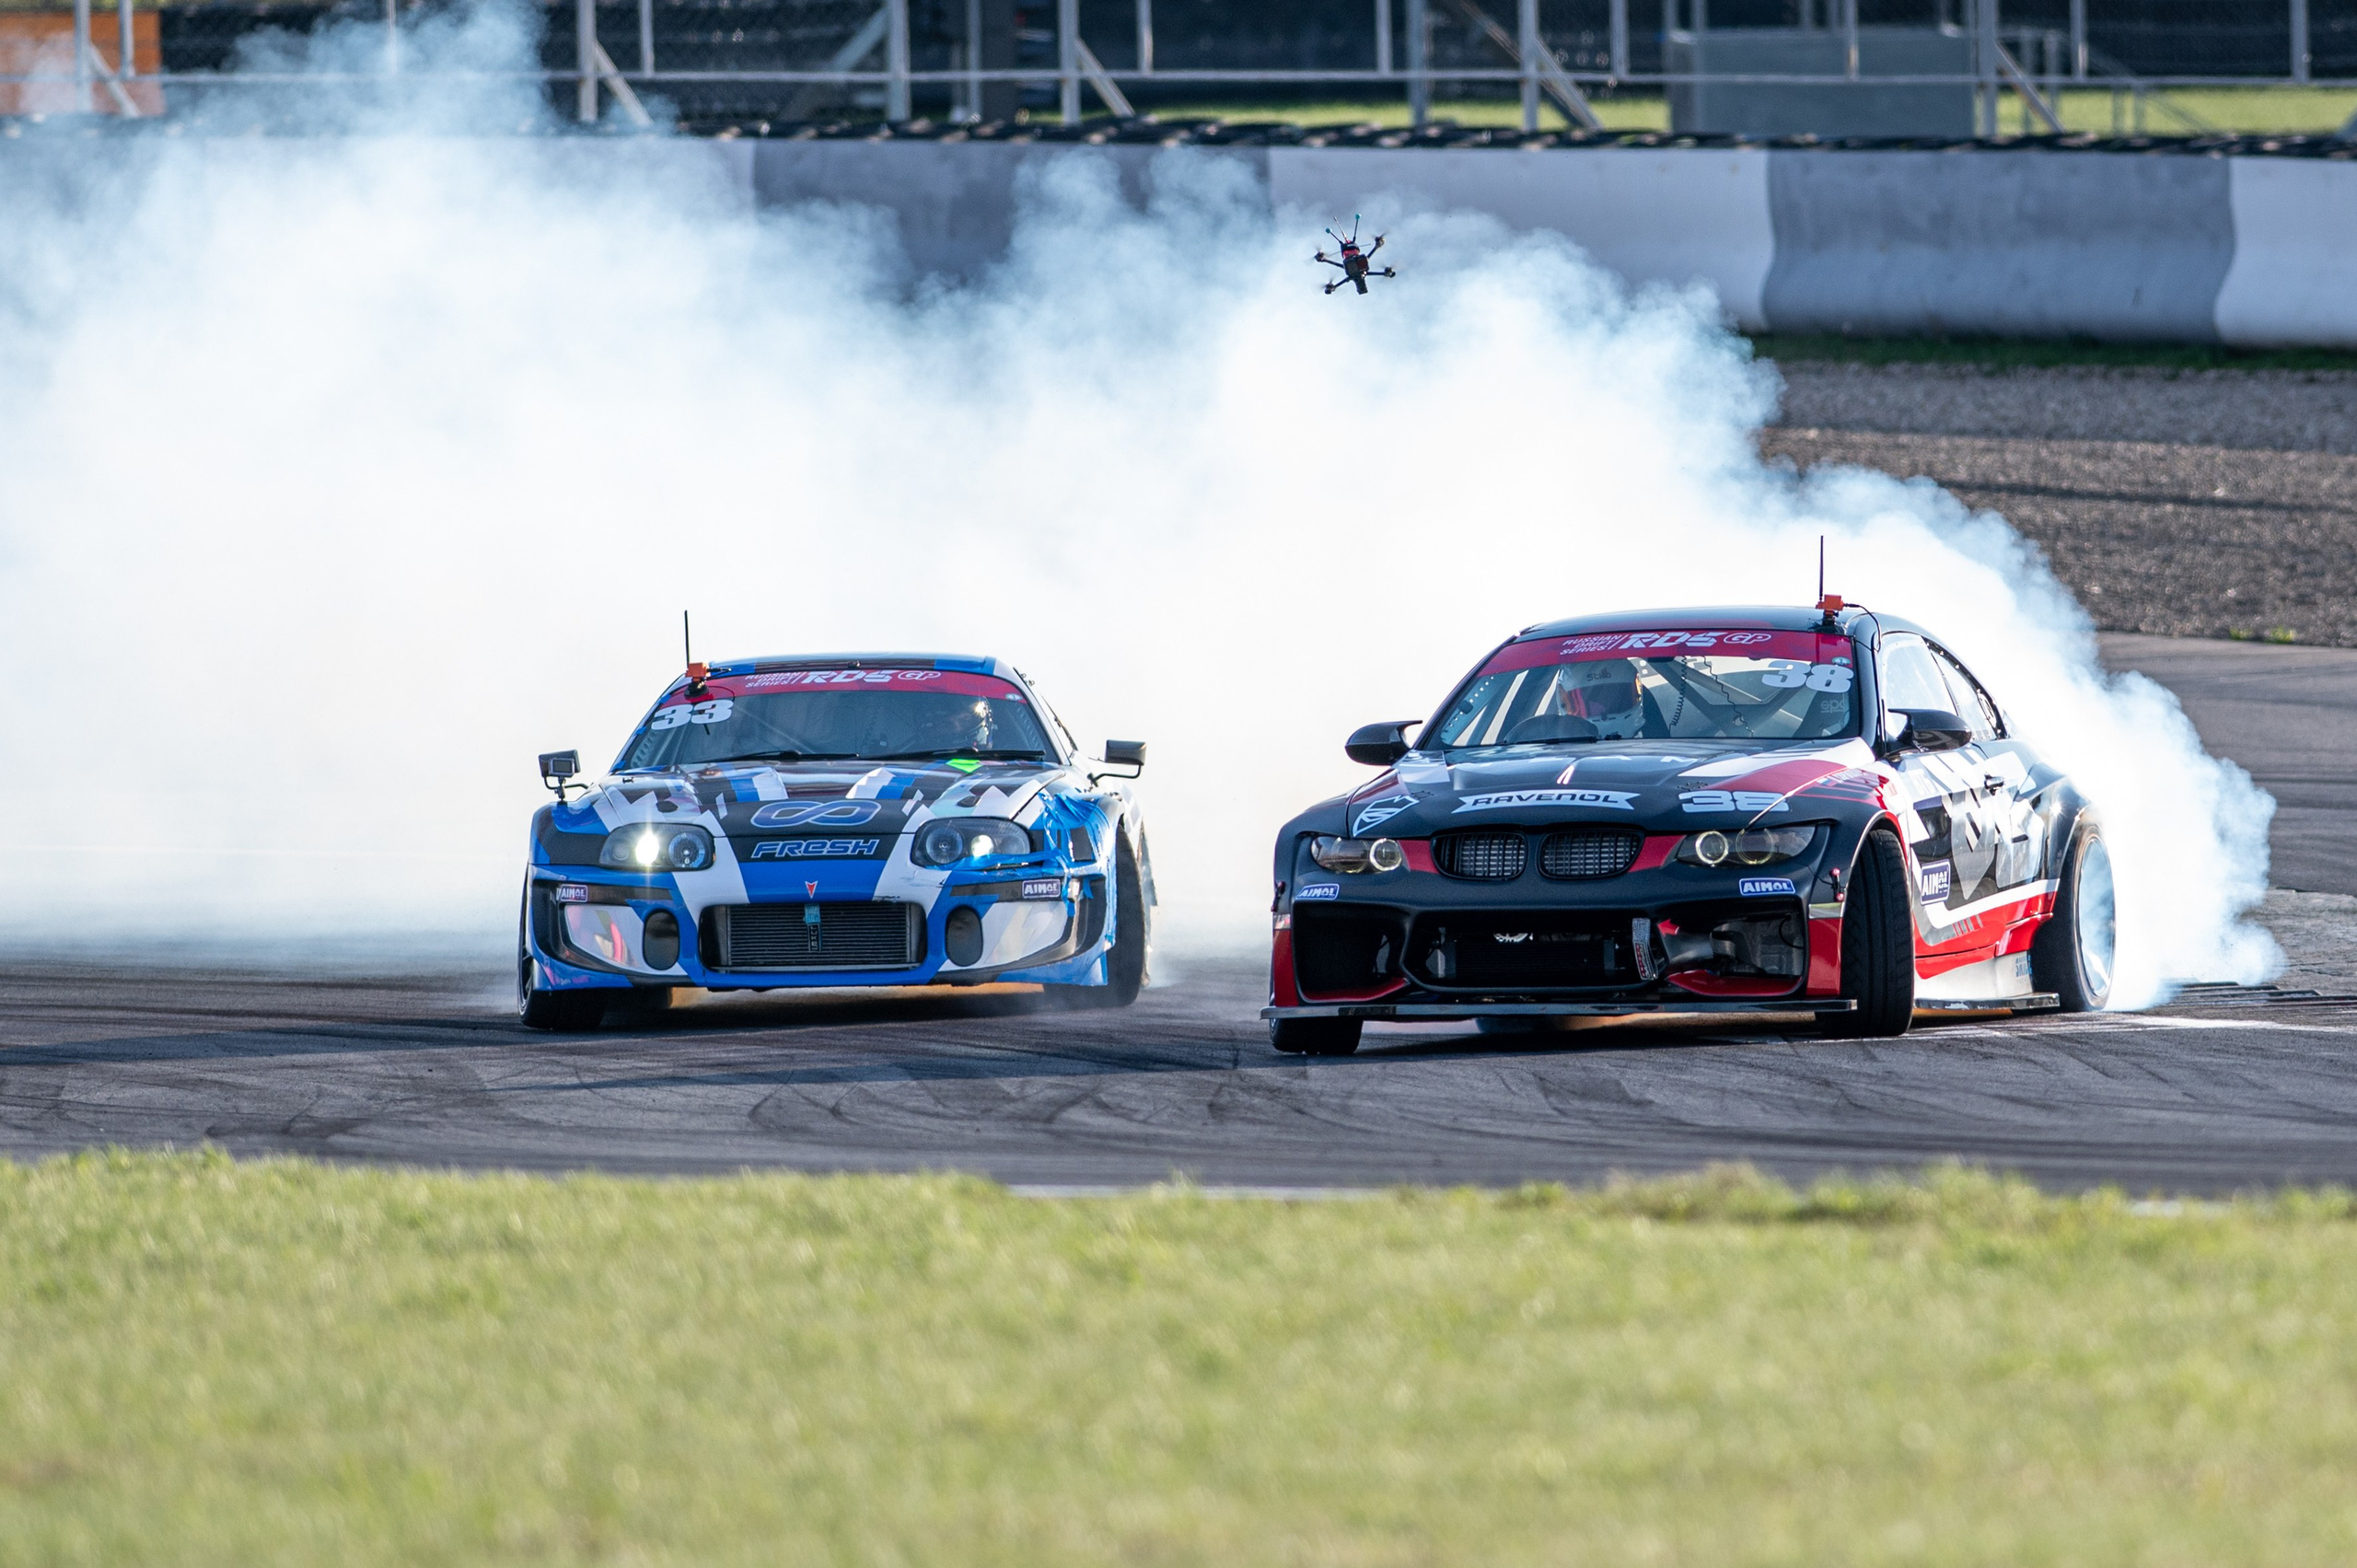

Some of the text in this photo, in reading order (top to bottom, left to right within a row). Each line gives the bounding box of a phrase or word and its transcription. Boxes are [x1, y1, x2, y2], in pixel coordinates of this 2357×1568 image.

[1562, 634, 1622, 645] RUSSIAN
[1573, 640, 1616, 649] DRIFT
[1619, 632, 1771, 649] RDS GP
[1560, 645, 1608, 655] SERIES
[745, 671, 802, 680] RUSSIAN
[801, 670, 941, 684] RDS GP
[1761, 659, 1854, 693] 38
[745, 679, 790, 688] SERIES
[651, 700, 734, 730] 33
[1471, 792, 1619, 807] RAVENOL
[1678, 790, 1790, 813] 38
[1024, 883, 1058, 894] AIMOL
[1743, 881, 1792, 893] AIMOL
[1922, 870, 1948, 896] AIMOL
[561, 888, 586, 899] AIMOL
[1297, 888, 1335, 898] AIMOL
